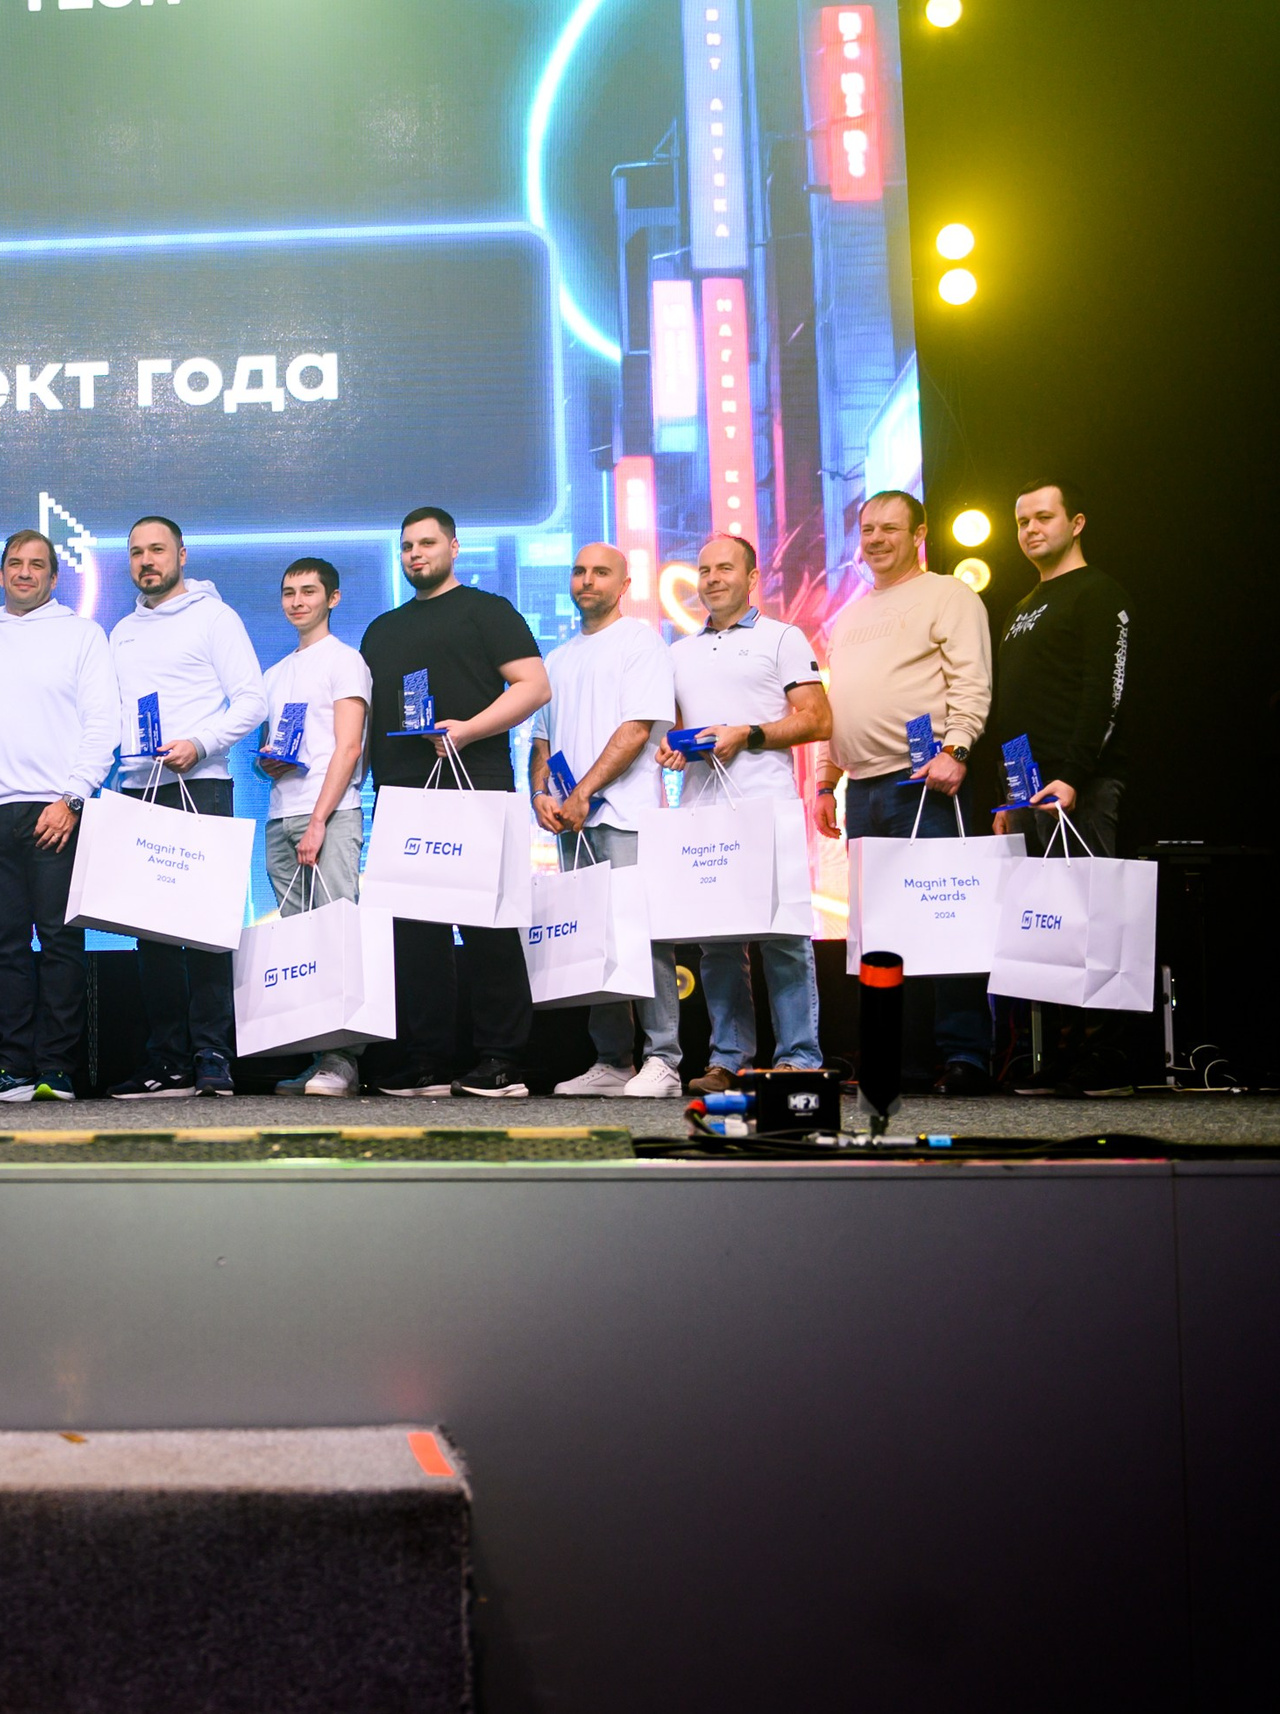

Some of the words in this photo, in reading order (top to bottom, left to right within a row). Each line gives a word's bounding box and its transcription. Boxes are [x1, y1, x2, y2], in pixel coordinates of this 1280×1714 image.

[137, 352, 341, 415] года
[136, 837, 176, 854] Magnit
[180, 848, 205, 861] Tech
[425, 841, 462, 856] TECH
[681, 844, 716, 857] Magnit
[719, 840, 740, 852] Tech
[148, 855, 189, 871] Awards
[692, 855, 728, 868] Awards
[157, 874, 176, 884] 2024
[700, 876, 716, 884] 2024
[904, 877, 947, 891] Magnit
[950, 875, 980, 887] Tech
[920, 890, 966, 902] Awards
[934, 911, 956, 919] 2024
[1035, 913, 1062, 930] TECH
[546, 920, 578, 939] TECH
[281, 960, 317, 981] TECH
[789, 1095, 816, 1110] MFX
